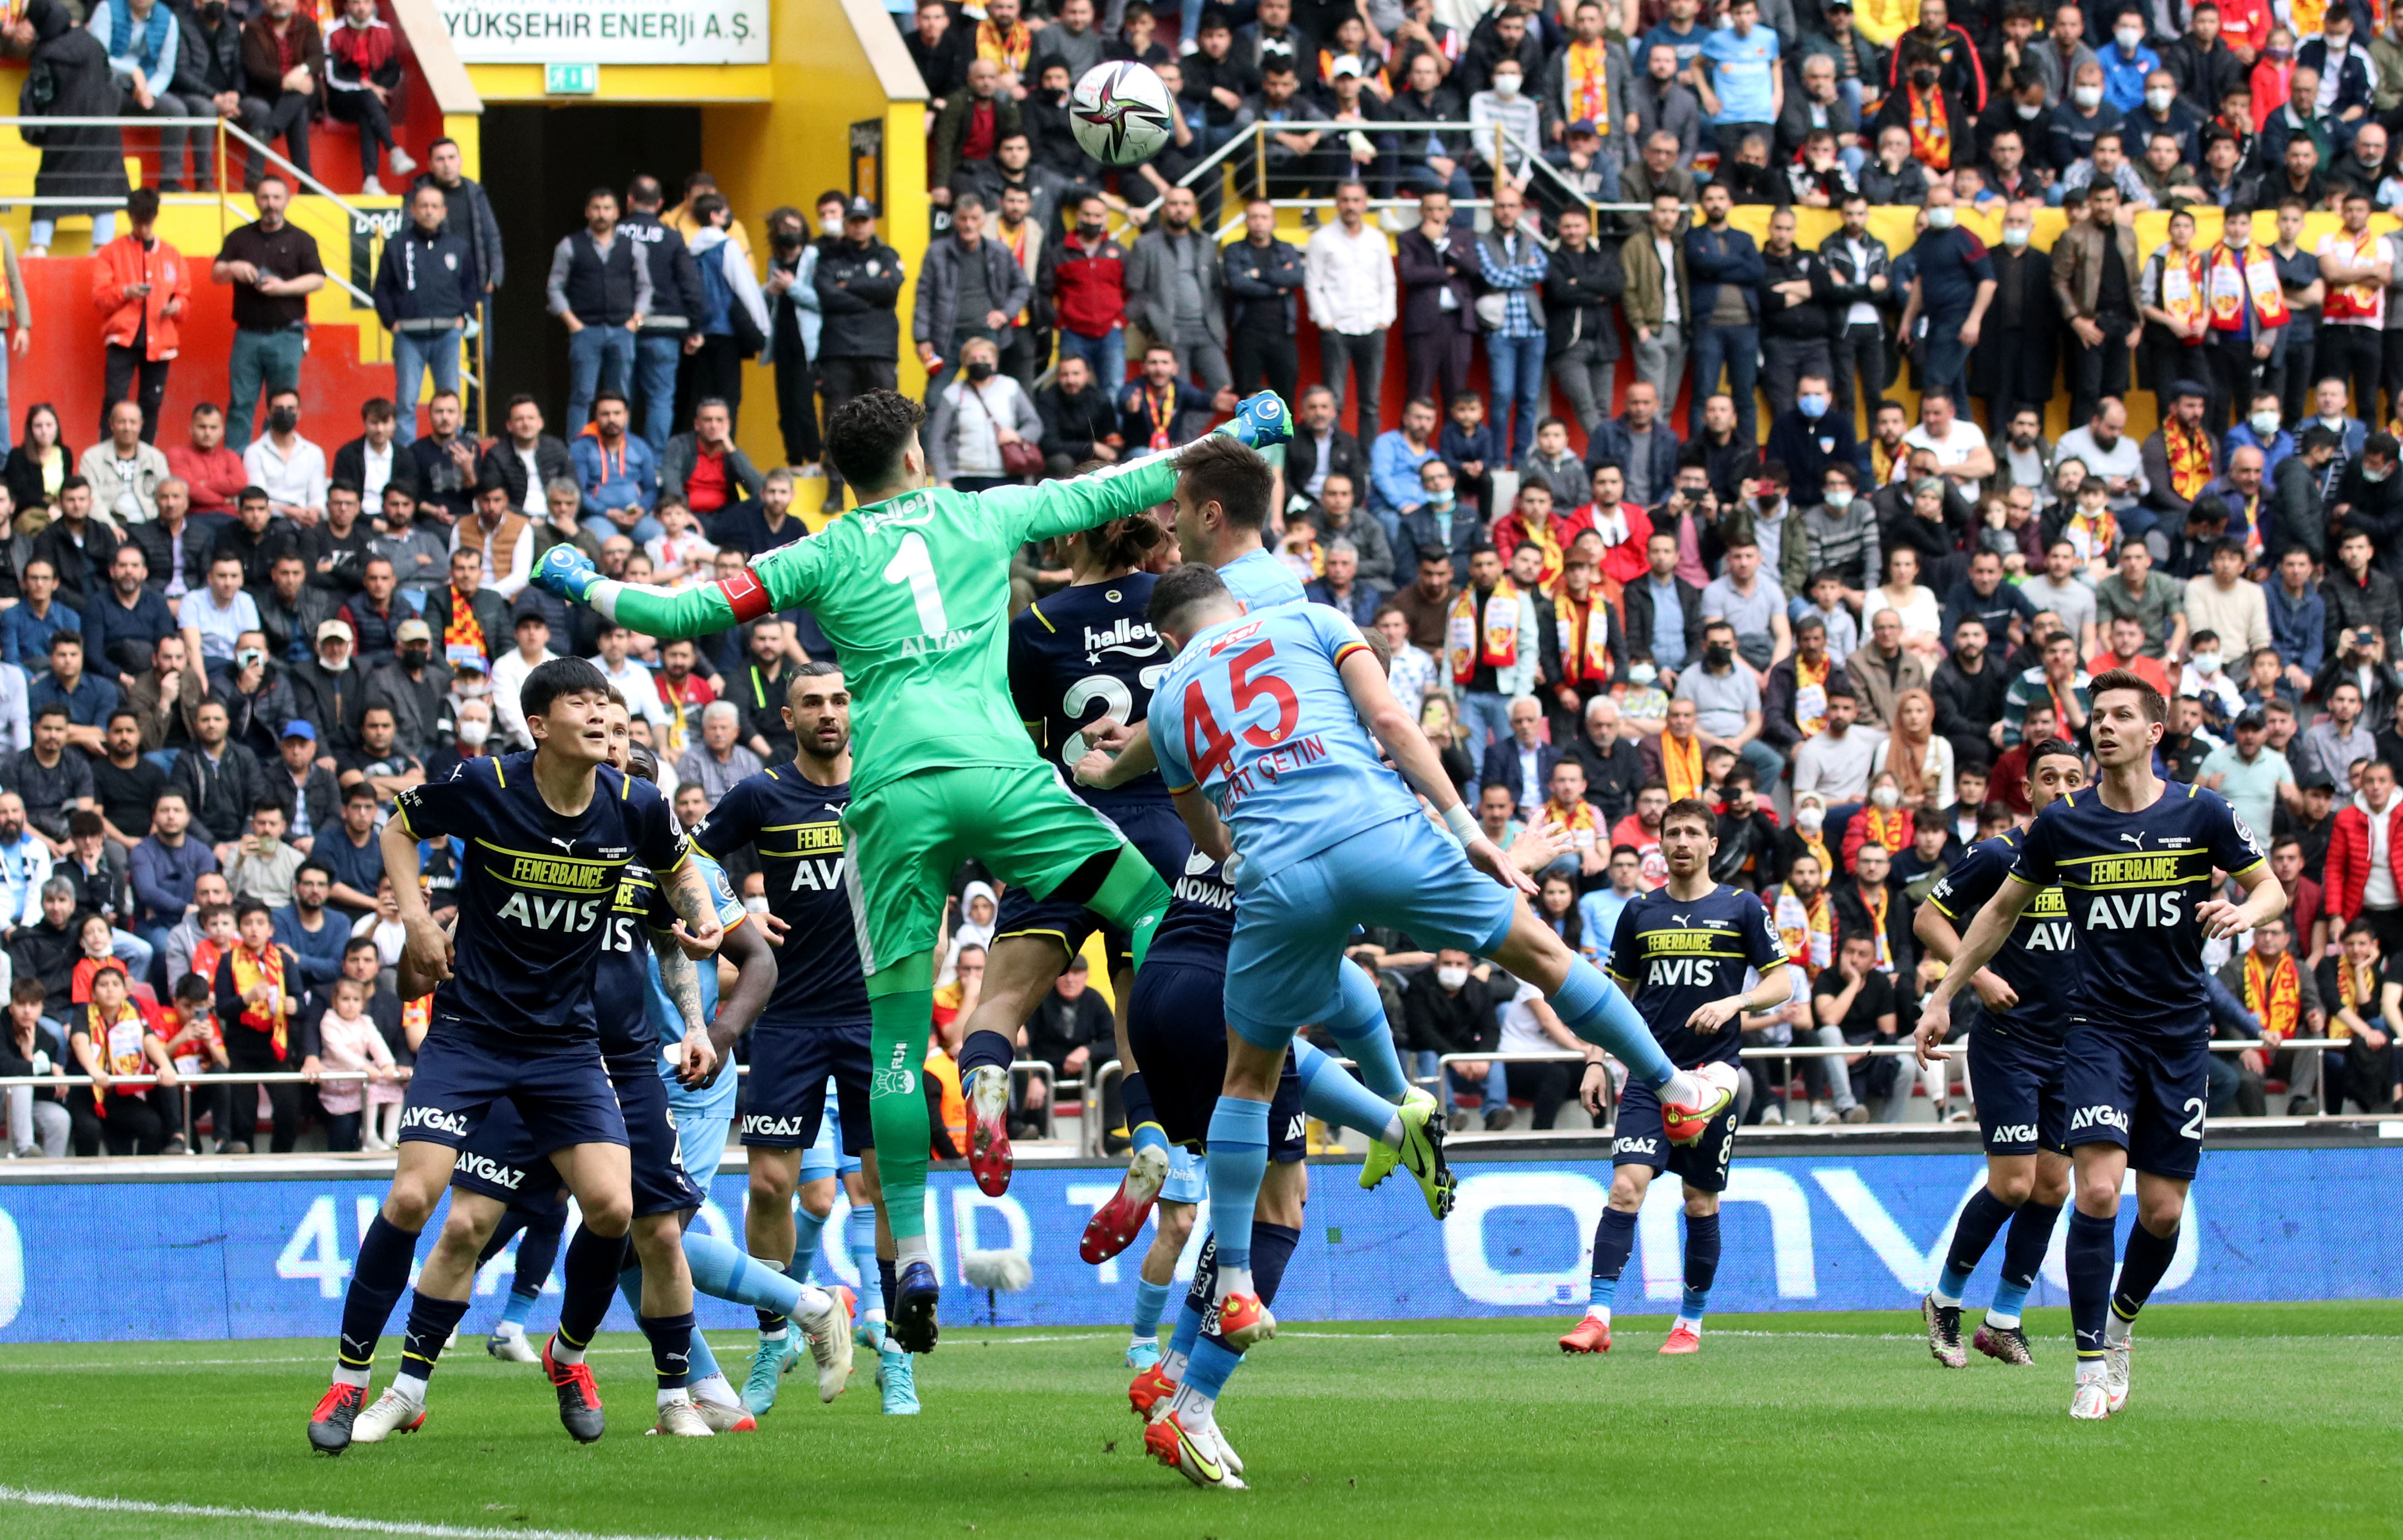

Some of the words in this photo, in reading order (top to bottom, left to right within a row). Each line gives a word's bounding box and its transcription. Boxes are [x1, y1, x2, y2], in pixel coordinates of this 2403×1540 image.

[858, 491, 936, 526] halley
[883, 531, 947, 636] 1
[1183, 638, 1300, 786] 45
[797, 826, 843, 849] FENERB
[512, 857, 607, 889] FENERBAHÇE
[790, 857, 846, 891] AV
[2090, 857, 2180, 884] FENERBAHÇE
[1172, 876, 1236, 911] NOVAK
[497, 892, 600, 933] AVIS
[2086, 890, 2182, 931] AVIS
[601, 917, 635, 952] IS
[1648, 933, 1714, 952] FENERBAHÇE
[2024, 921, 2076, 951] AV
[1648, 958, 1716, 987] AVIS
[400, 1106, 468, 1136] AYGAZ
[740, 1114, 803, 1136] AYGAZ
[1992, 1123, 2040, 1143] AYGA
[2070, 1104, 2129, 1135] AYGAZ
[1718, 1134, 1733, 1165] 8
[454, 1150, 526, 1190] AYGAZ
